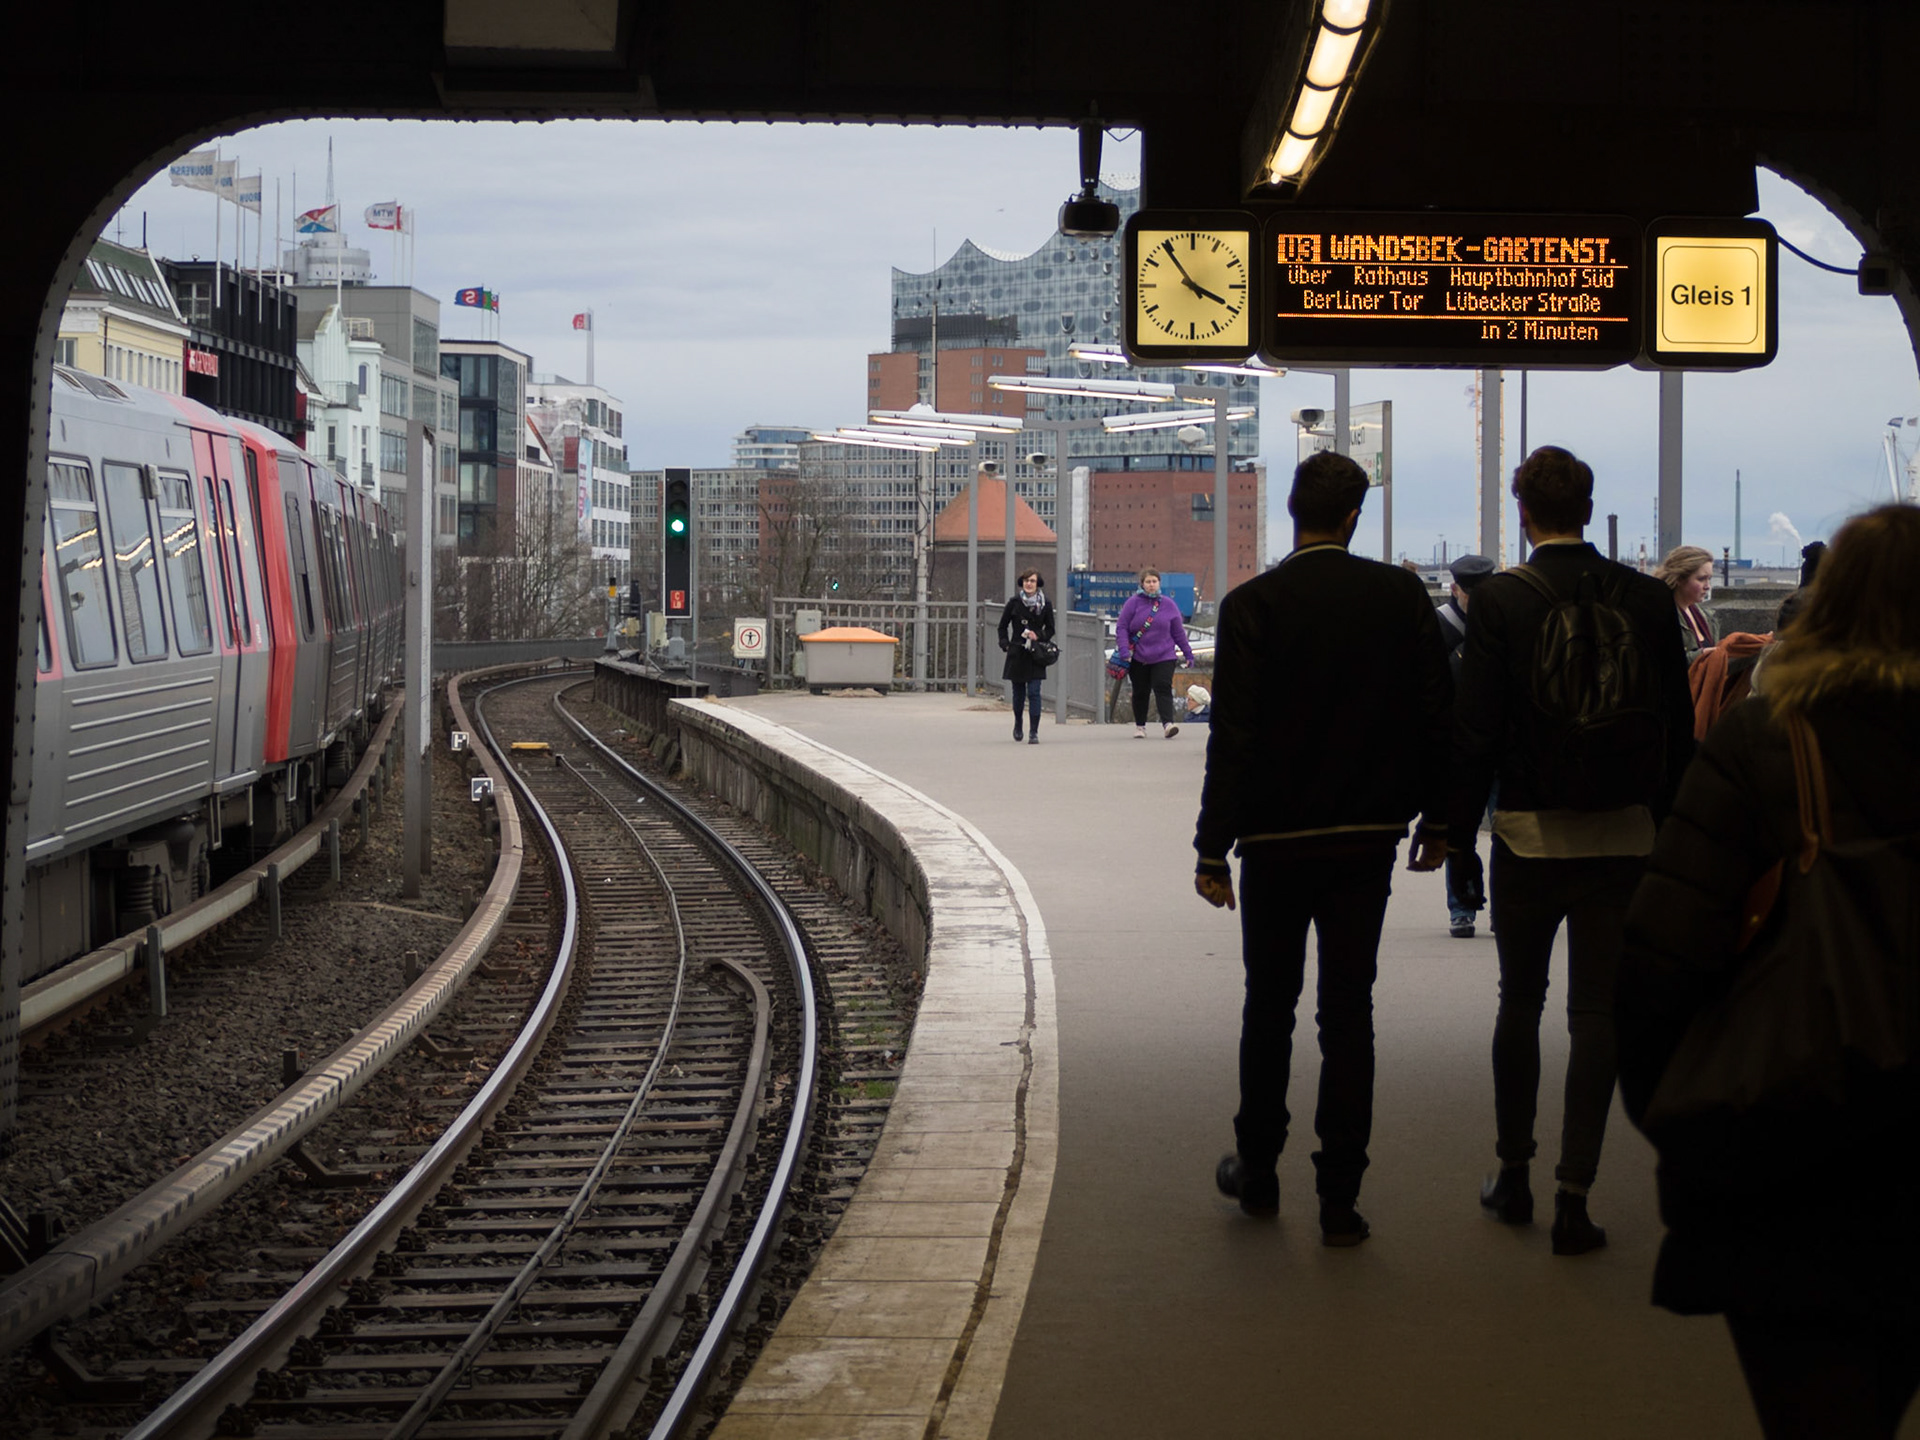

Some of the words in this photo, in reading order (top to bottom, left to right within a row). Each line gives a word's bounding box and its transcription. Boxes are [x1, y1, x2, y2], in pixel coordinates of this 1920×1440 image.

[1281, 235, 1317, 262] U3
[1330, 235, 1616, 263] WANDSBEK-GARTENST.
[1354, 266, 1428, 286] Rathaus
[1450, 267, 1577, 291] Hauptbahnhof
[1582, 268, 1614, 289] Süd
[1303, 290, 1384, 311] Berliner
[1389, 291, 1424, 311] Tor
[1446, 292, 1533, 312] Lübecker
[1537, 293, 1601, 313] Straße
[1670, 284, 1734, 306] Gleis
[1741, 285, 1751, 306] 1
[1481, 321, 1500, 340] in
[1507, 321, 1518, 340] 2
[1525, 321, 1599, 341] Minuten
